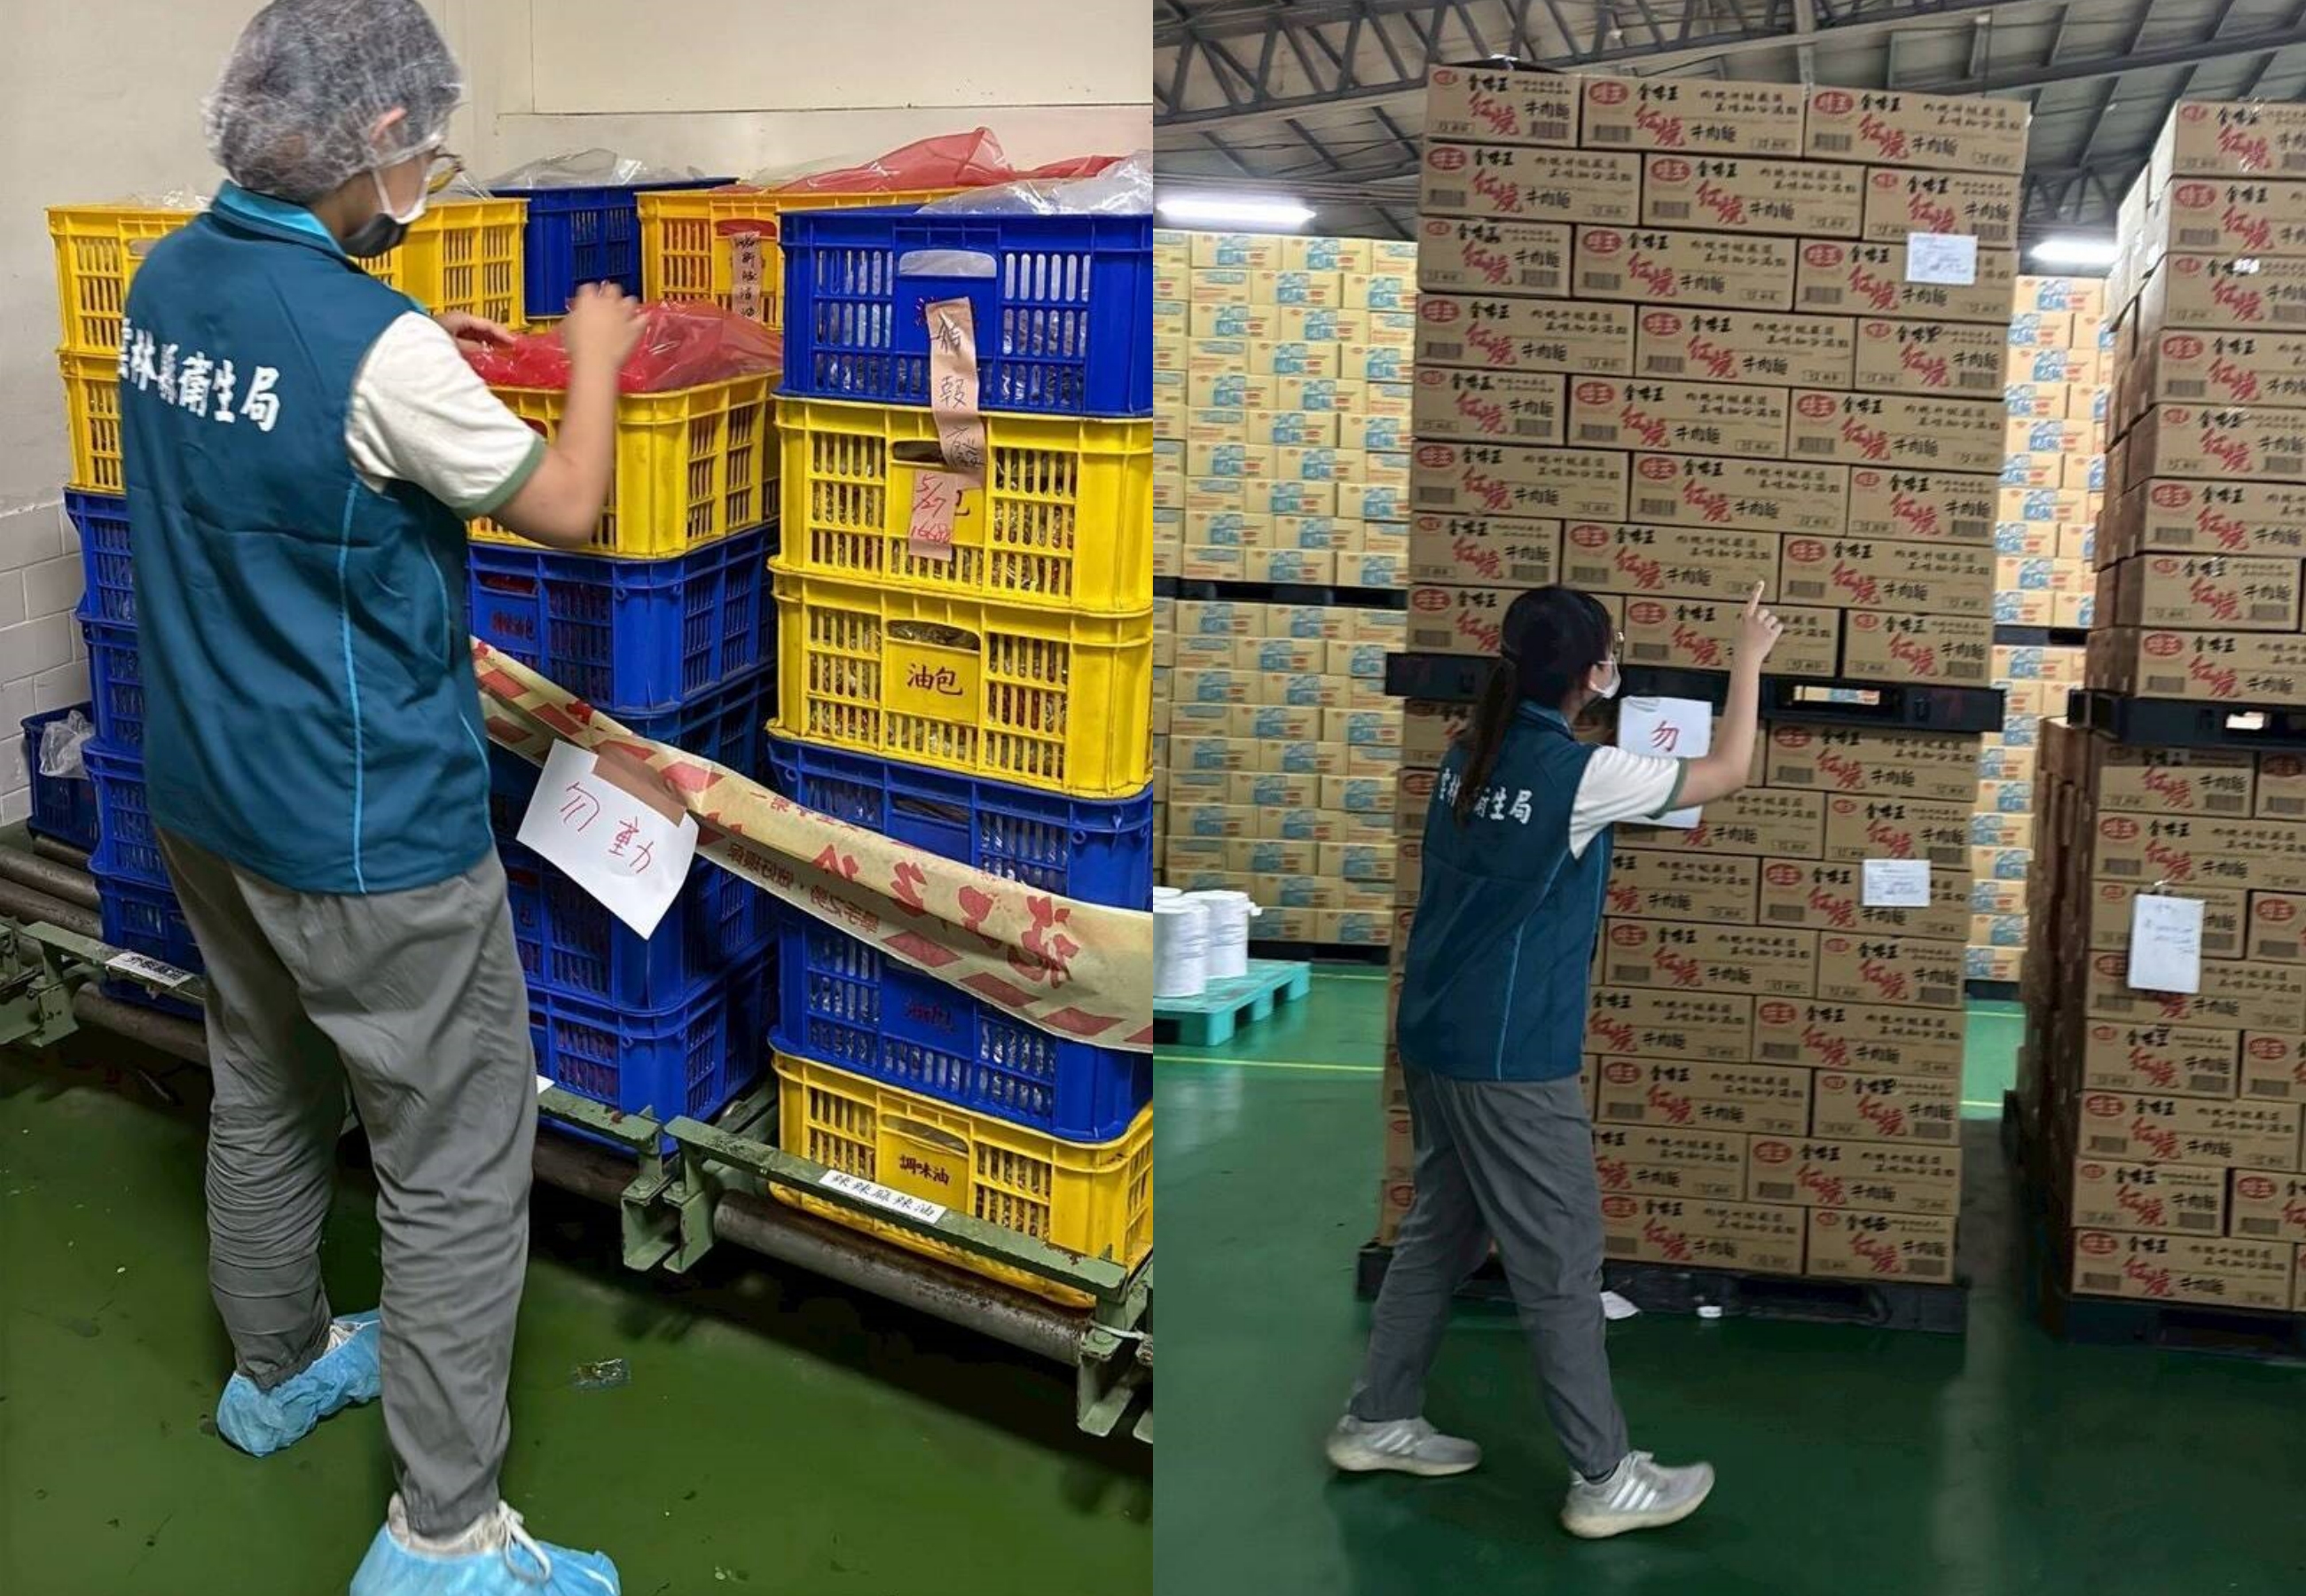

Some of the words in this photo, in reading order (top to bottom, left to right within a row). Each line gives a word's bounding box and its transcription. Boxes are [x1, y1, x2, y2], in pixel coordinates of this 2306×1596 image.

[906, 663, 964, 696] 油包
[1651, 720, 1681, 752] 勿
[561, 781, 655, 874] 勿動
[899, 1154, 950, 1185] 調味油
